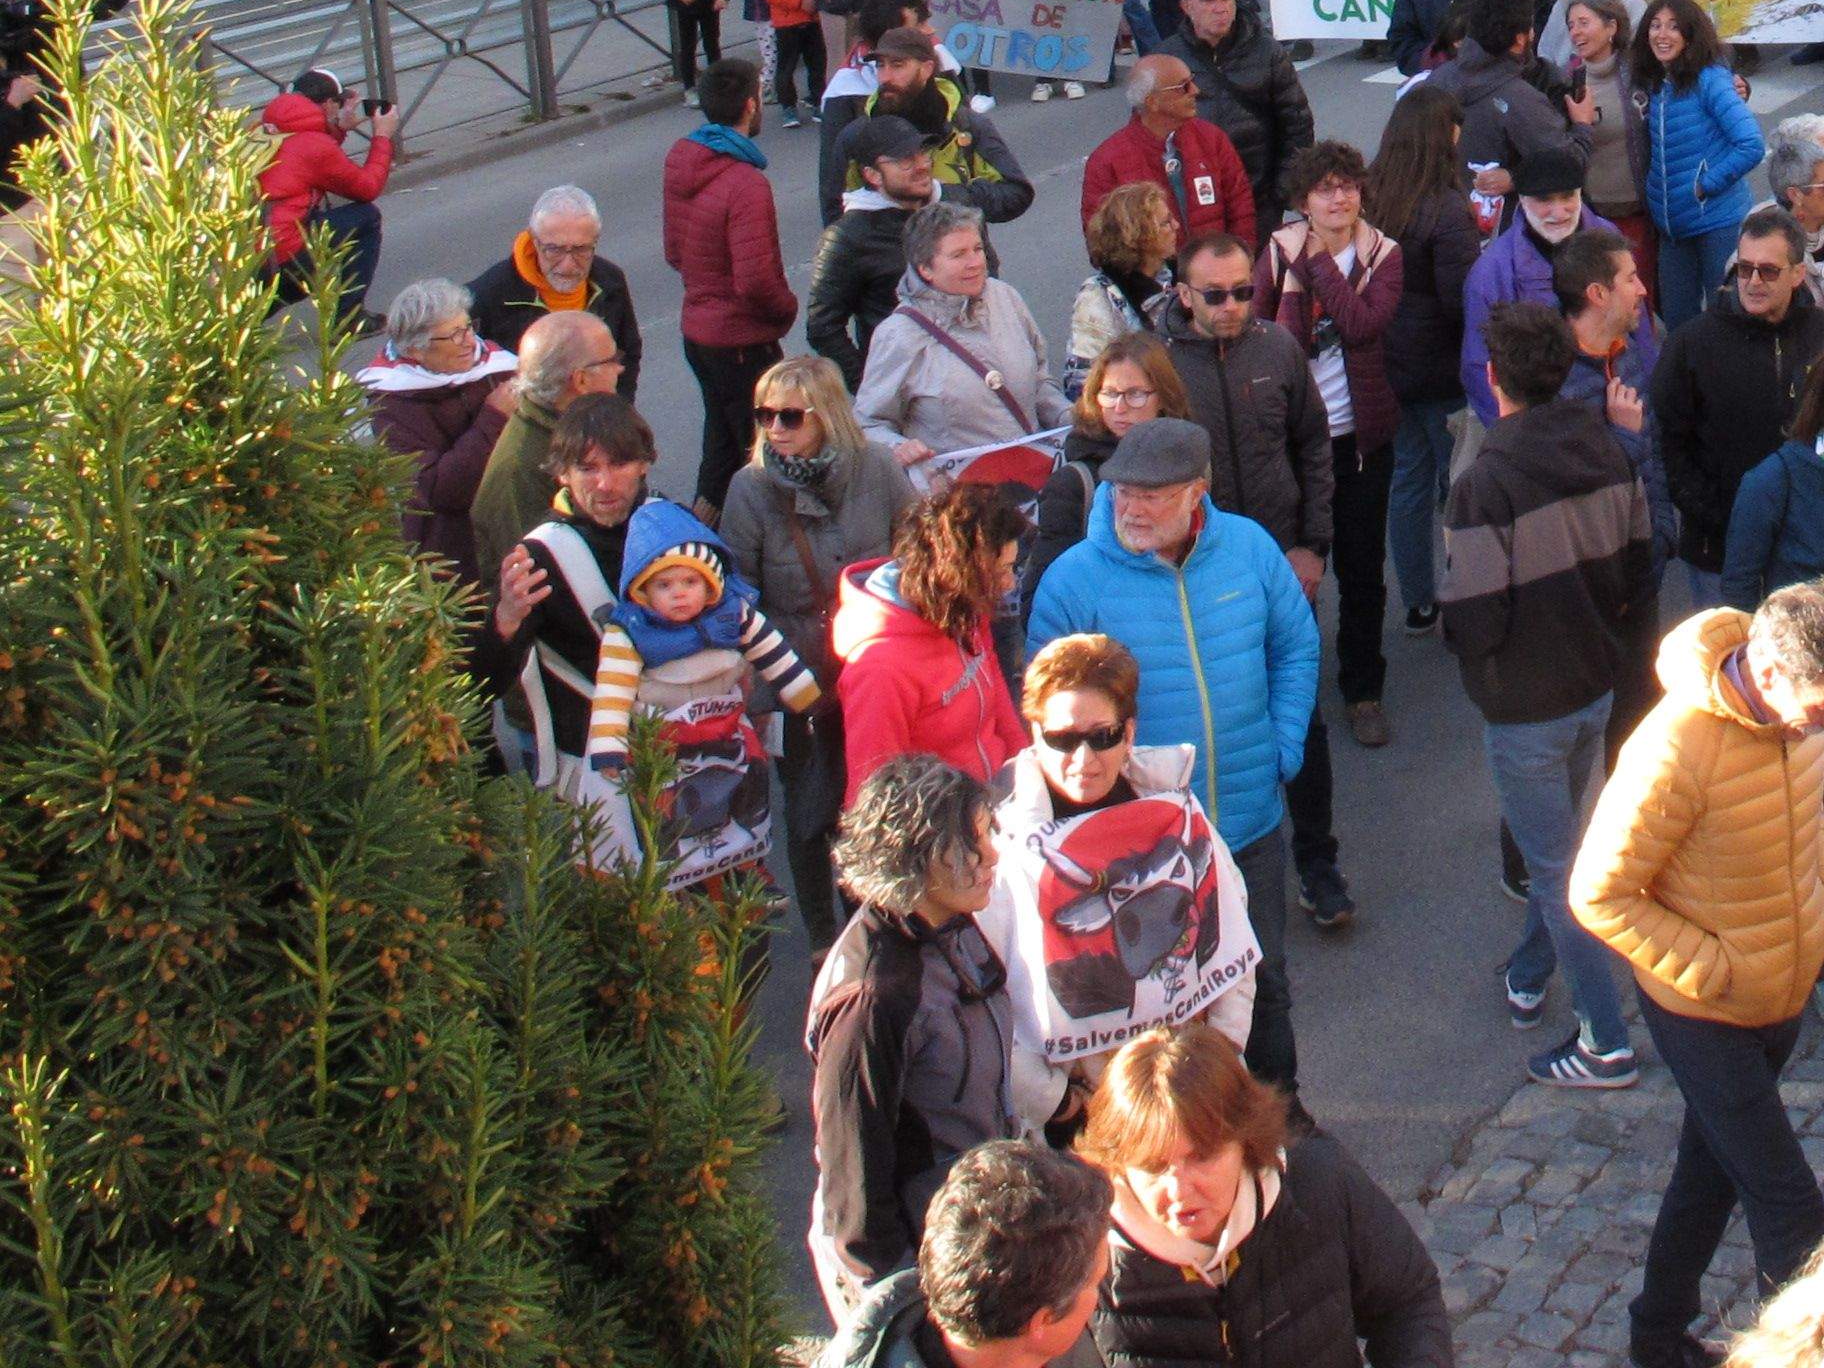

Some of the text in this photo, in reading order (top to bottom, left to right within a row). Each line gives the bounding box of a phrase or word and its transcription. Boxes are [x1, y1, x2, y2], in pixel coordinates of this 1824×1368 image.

[1031, 4, 1067, 29] DE
[945, 21, 1094, 73] OTROS
[1044, 947, 1256, 1056] #SalvemosCanalRoya
